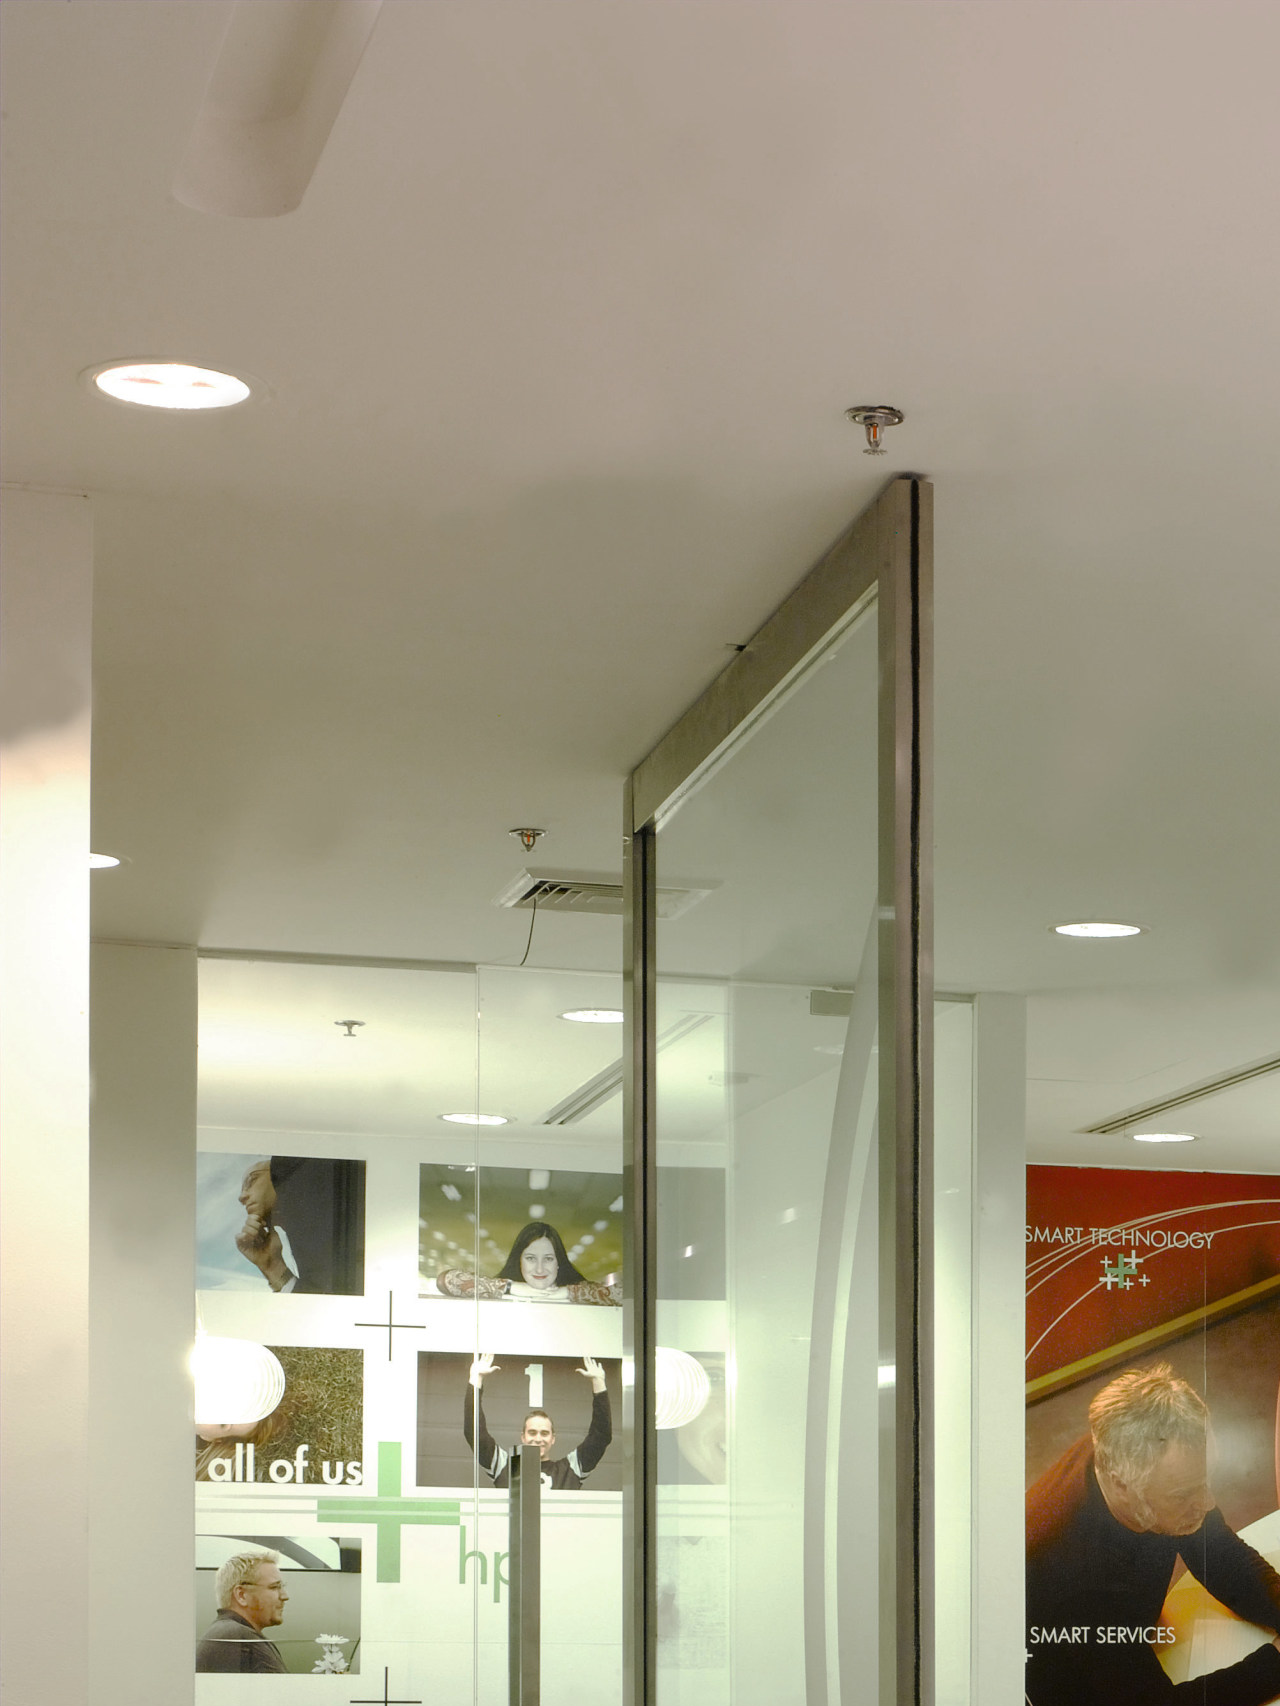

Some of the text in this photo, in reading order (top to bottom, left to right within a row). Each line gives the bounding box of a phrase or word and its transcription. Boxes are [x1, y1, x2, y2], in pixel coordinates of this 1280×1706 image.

[1025, 1225, 1215, 1250] SMART TECHNOLOGY
[208, 1443, 363, 1485] all of us
[1030, 1626, 1176, 1644] SMART SERVICES
